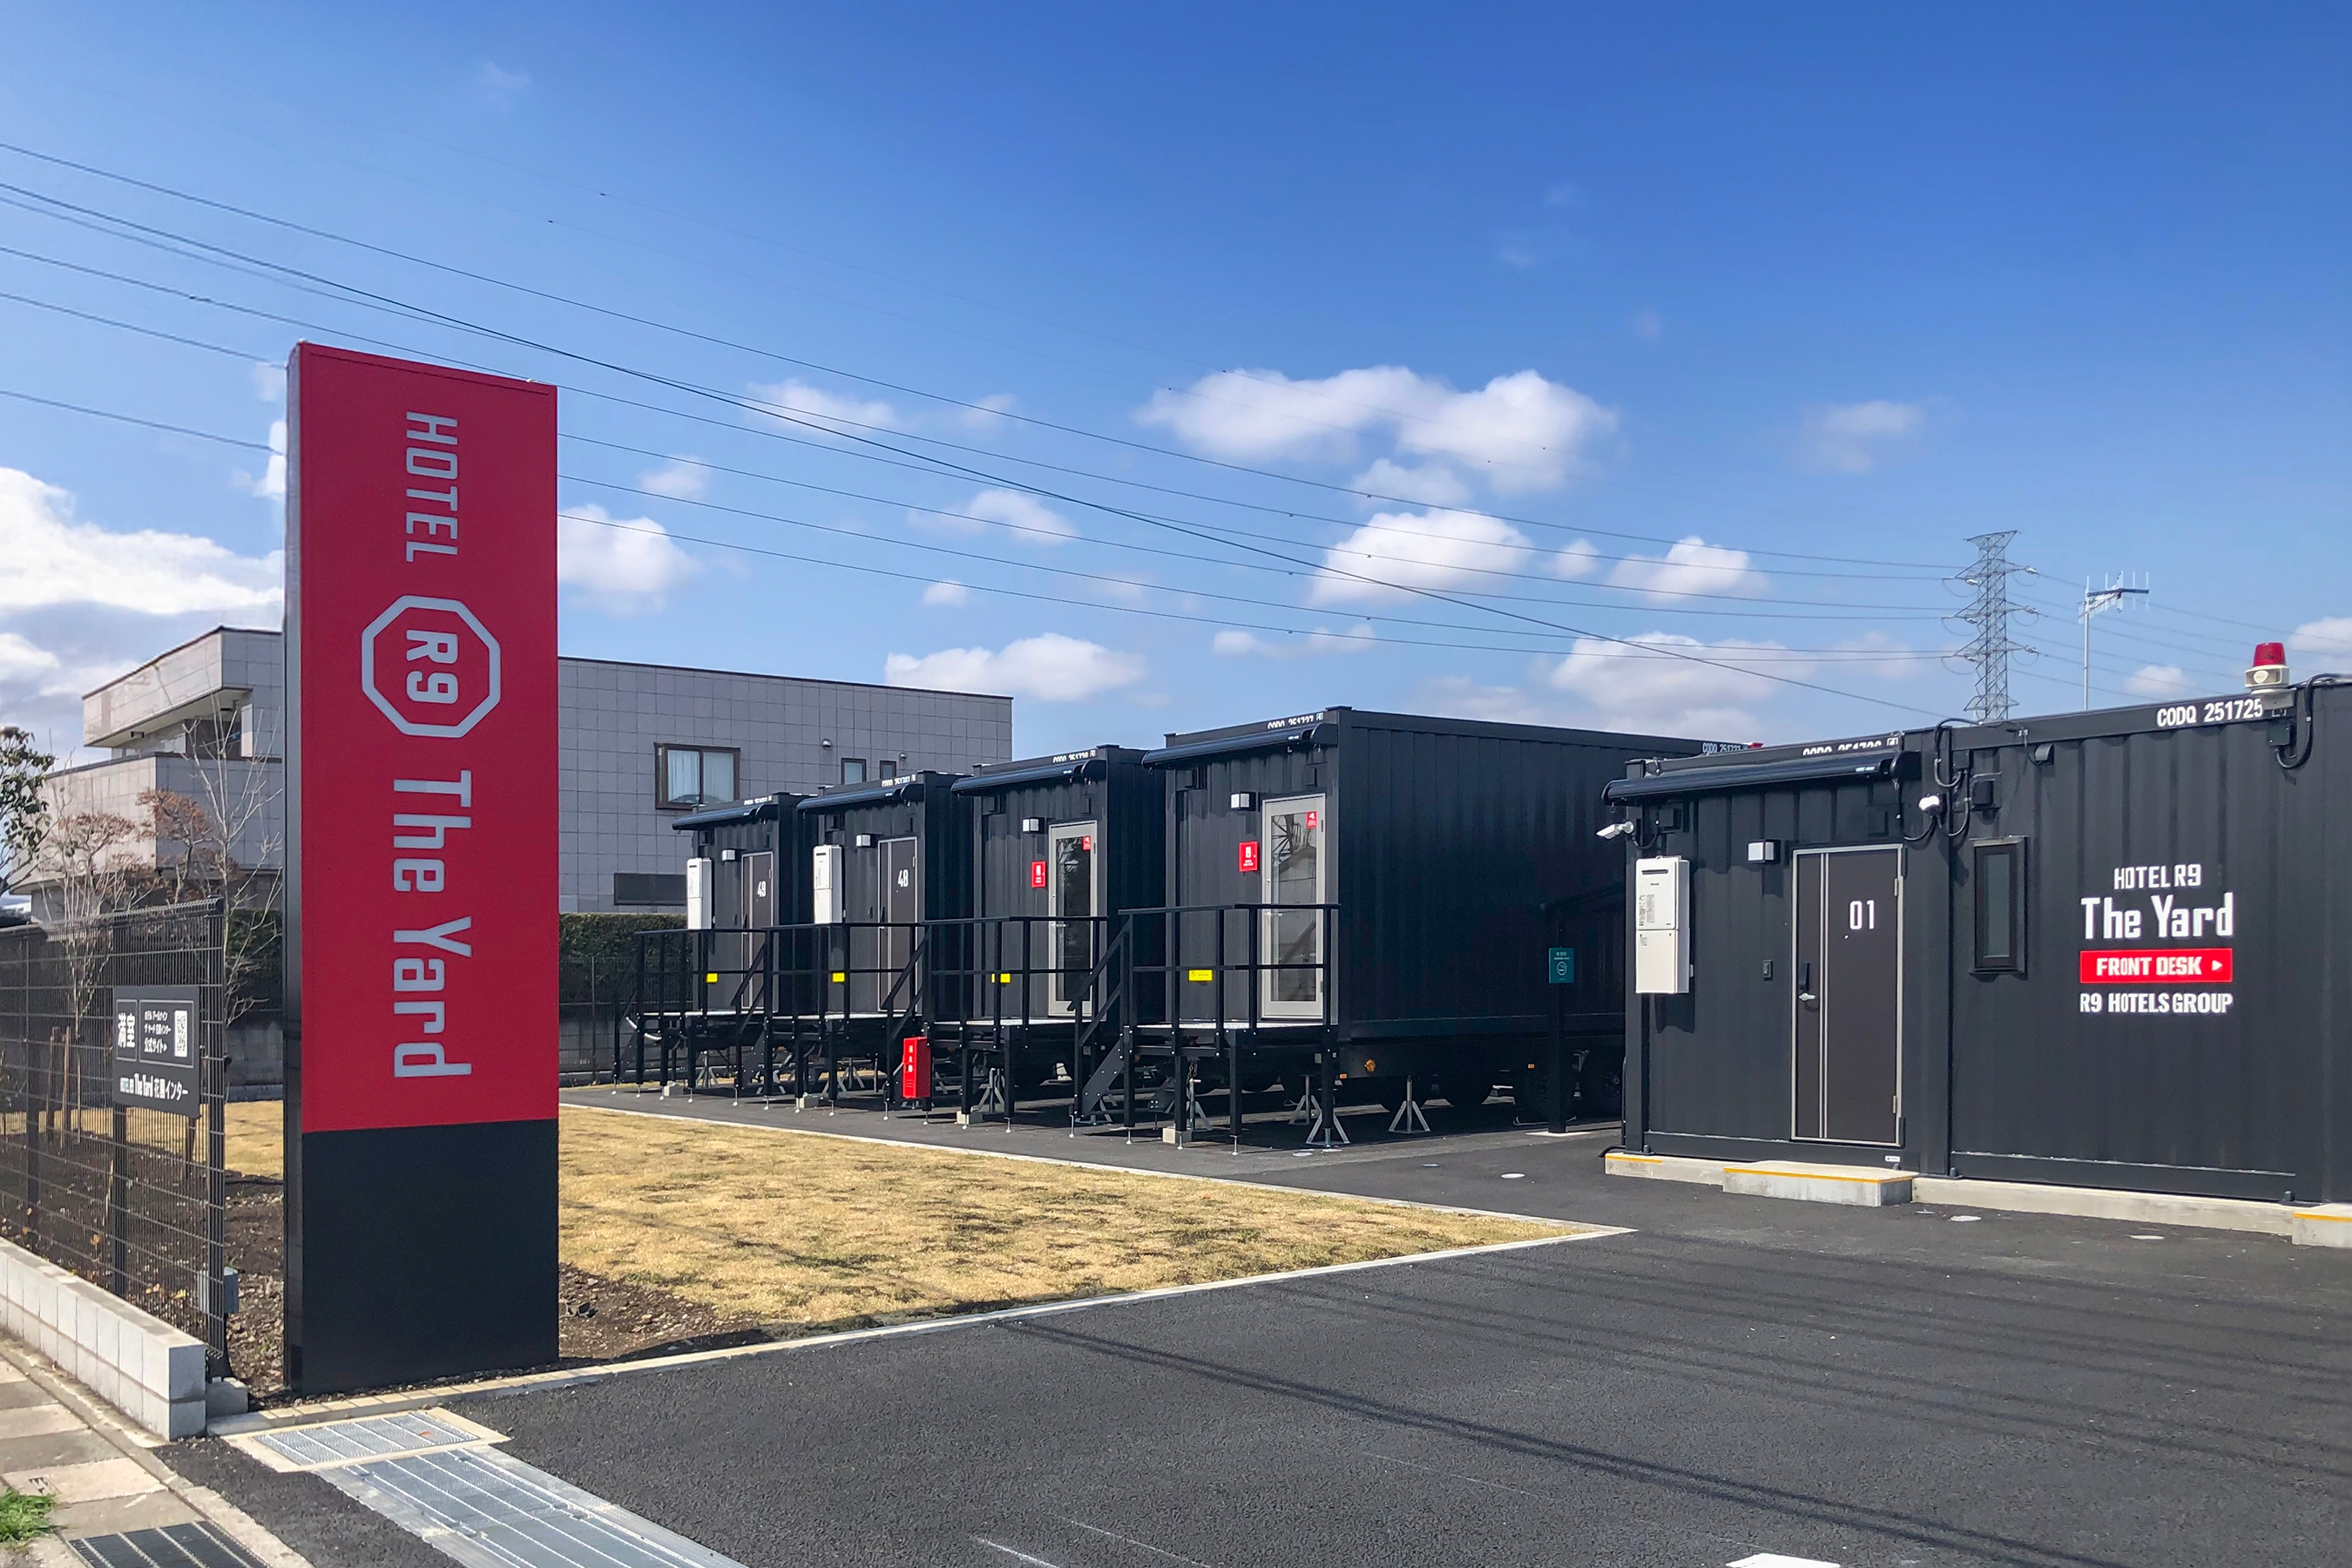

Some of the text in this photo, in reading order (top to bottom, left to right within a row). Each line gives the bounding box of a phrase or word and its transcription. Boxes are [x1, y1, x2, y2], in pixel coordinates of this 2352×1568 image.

[2157, 698, 2263, 727] CODQ 251725
[394, 411, 472, 1078] HOTEL R9 The Yard
[757, 880, 767, 897] 49
[897, 869, 909, 887] 48
[2113, 863, 2201, 889] HOTEL R9
[1849, 900, 1875, 929] 01
[2080, 892, 2234, 939] The Yard
[2096, 956, 2202, 976] FRONT DESK
[2080, 993, 2234, 1013] R9 HOTELS GROUP
[118, 1012, 135, 1048] 満室
